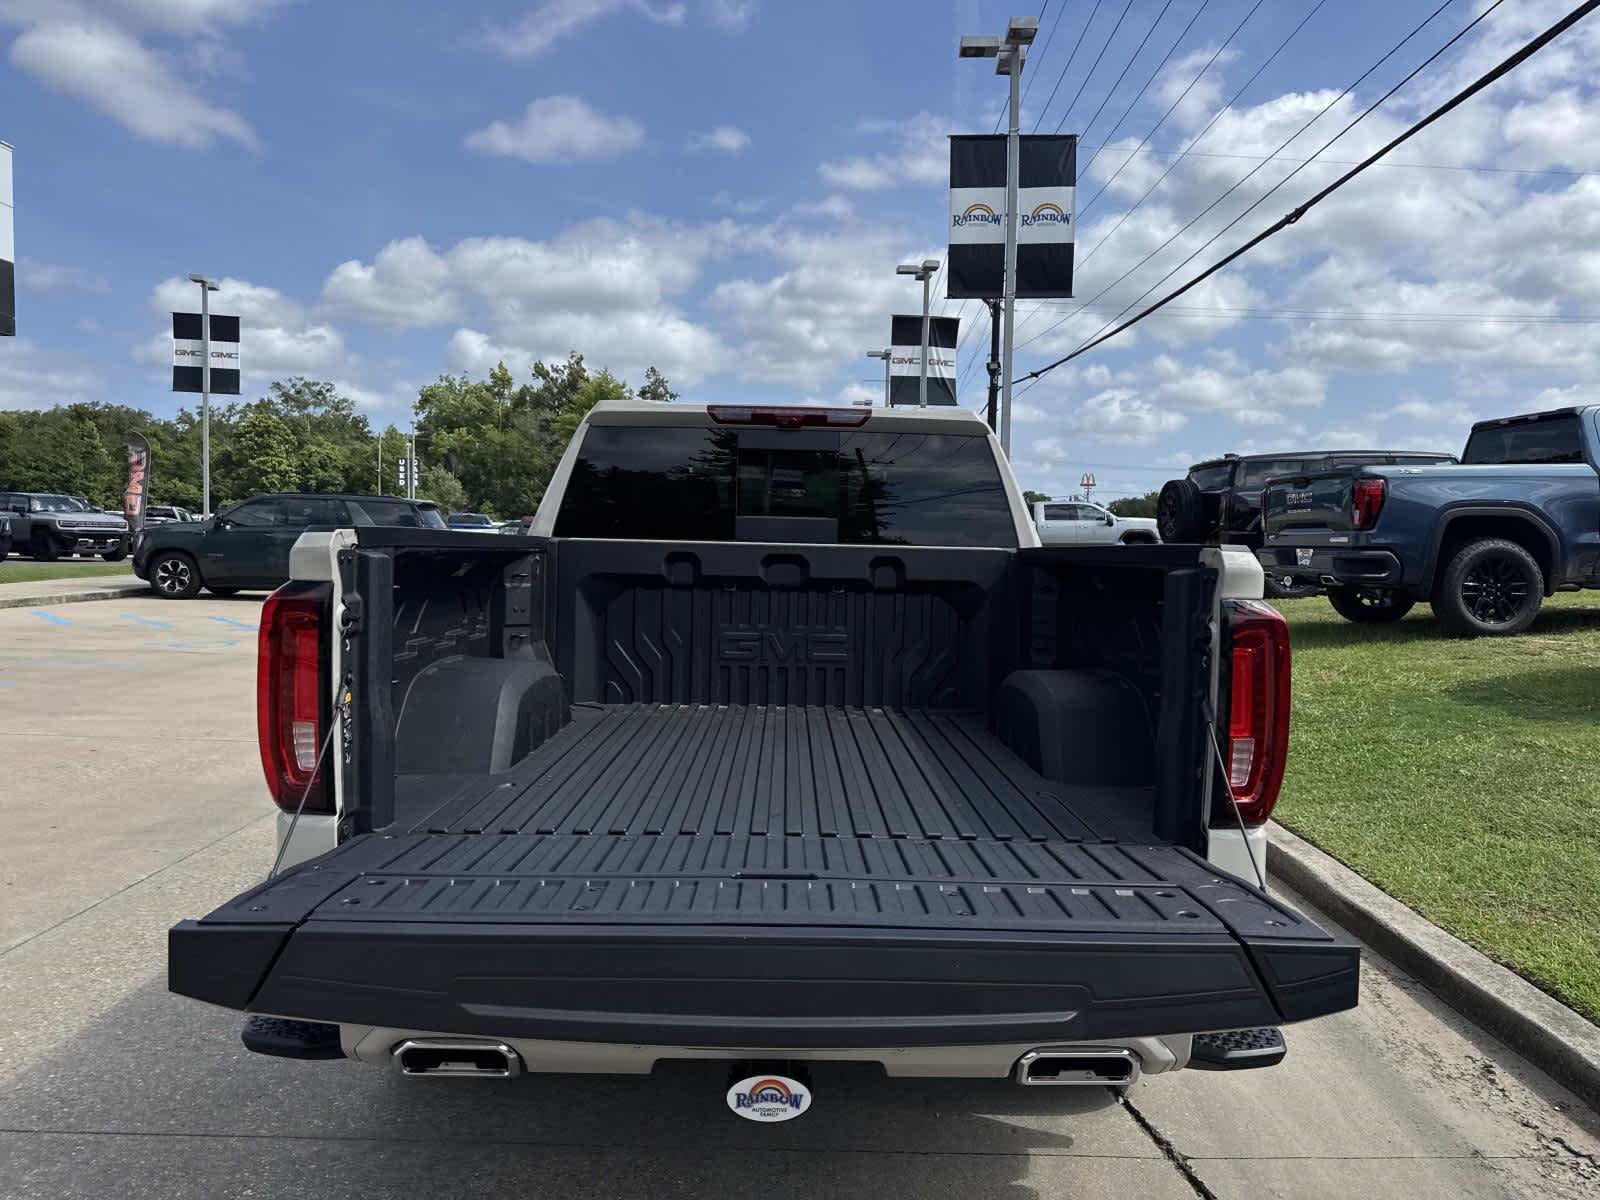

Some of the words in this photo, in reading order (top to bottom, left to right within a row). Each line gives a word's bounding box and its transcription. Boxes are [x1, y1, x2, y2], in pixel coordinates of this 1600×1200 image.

[952, 214, 1002, 227] RAINBOW
[1021, 213, 1072, 226] RAINBOW
[175, 349, 203, 357] GMC
[211, 351, 239, 360] GMC
[892, 357, 921, 365] GMC
[928, 358, 955, 367] GMC
[719, 629, 849, 661] GMC
[736, 1093, 803, 1110] RAINBOW
